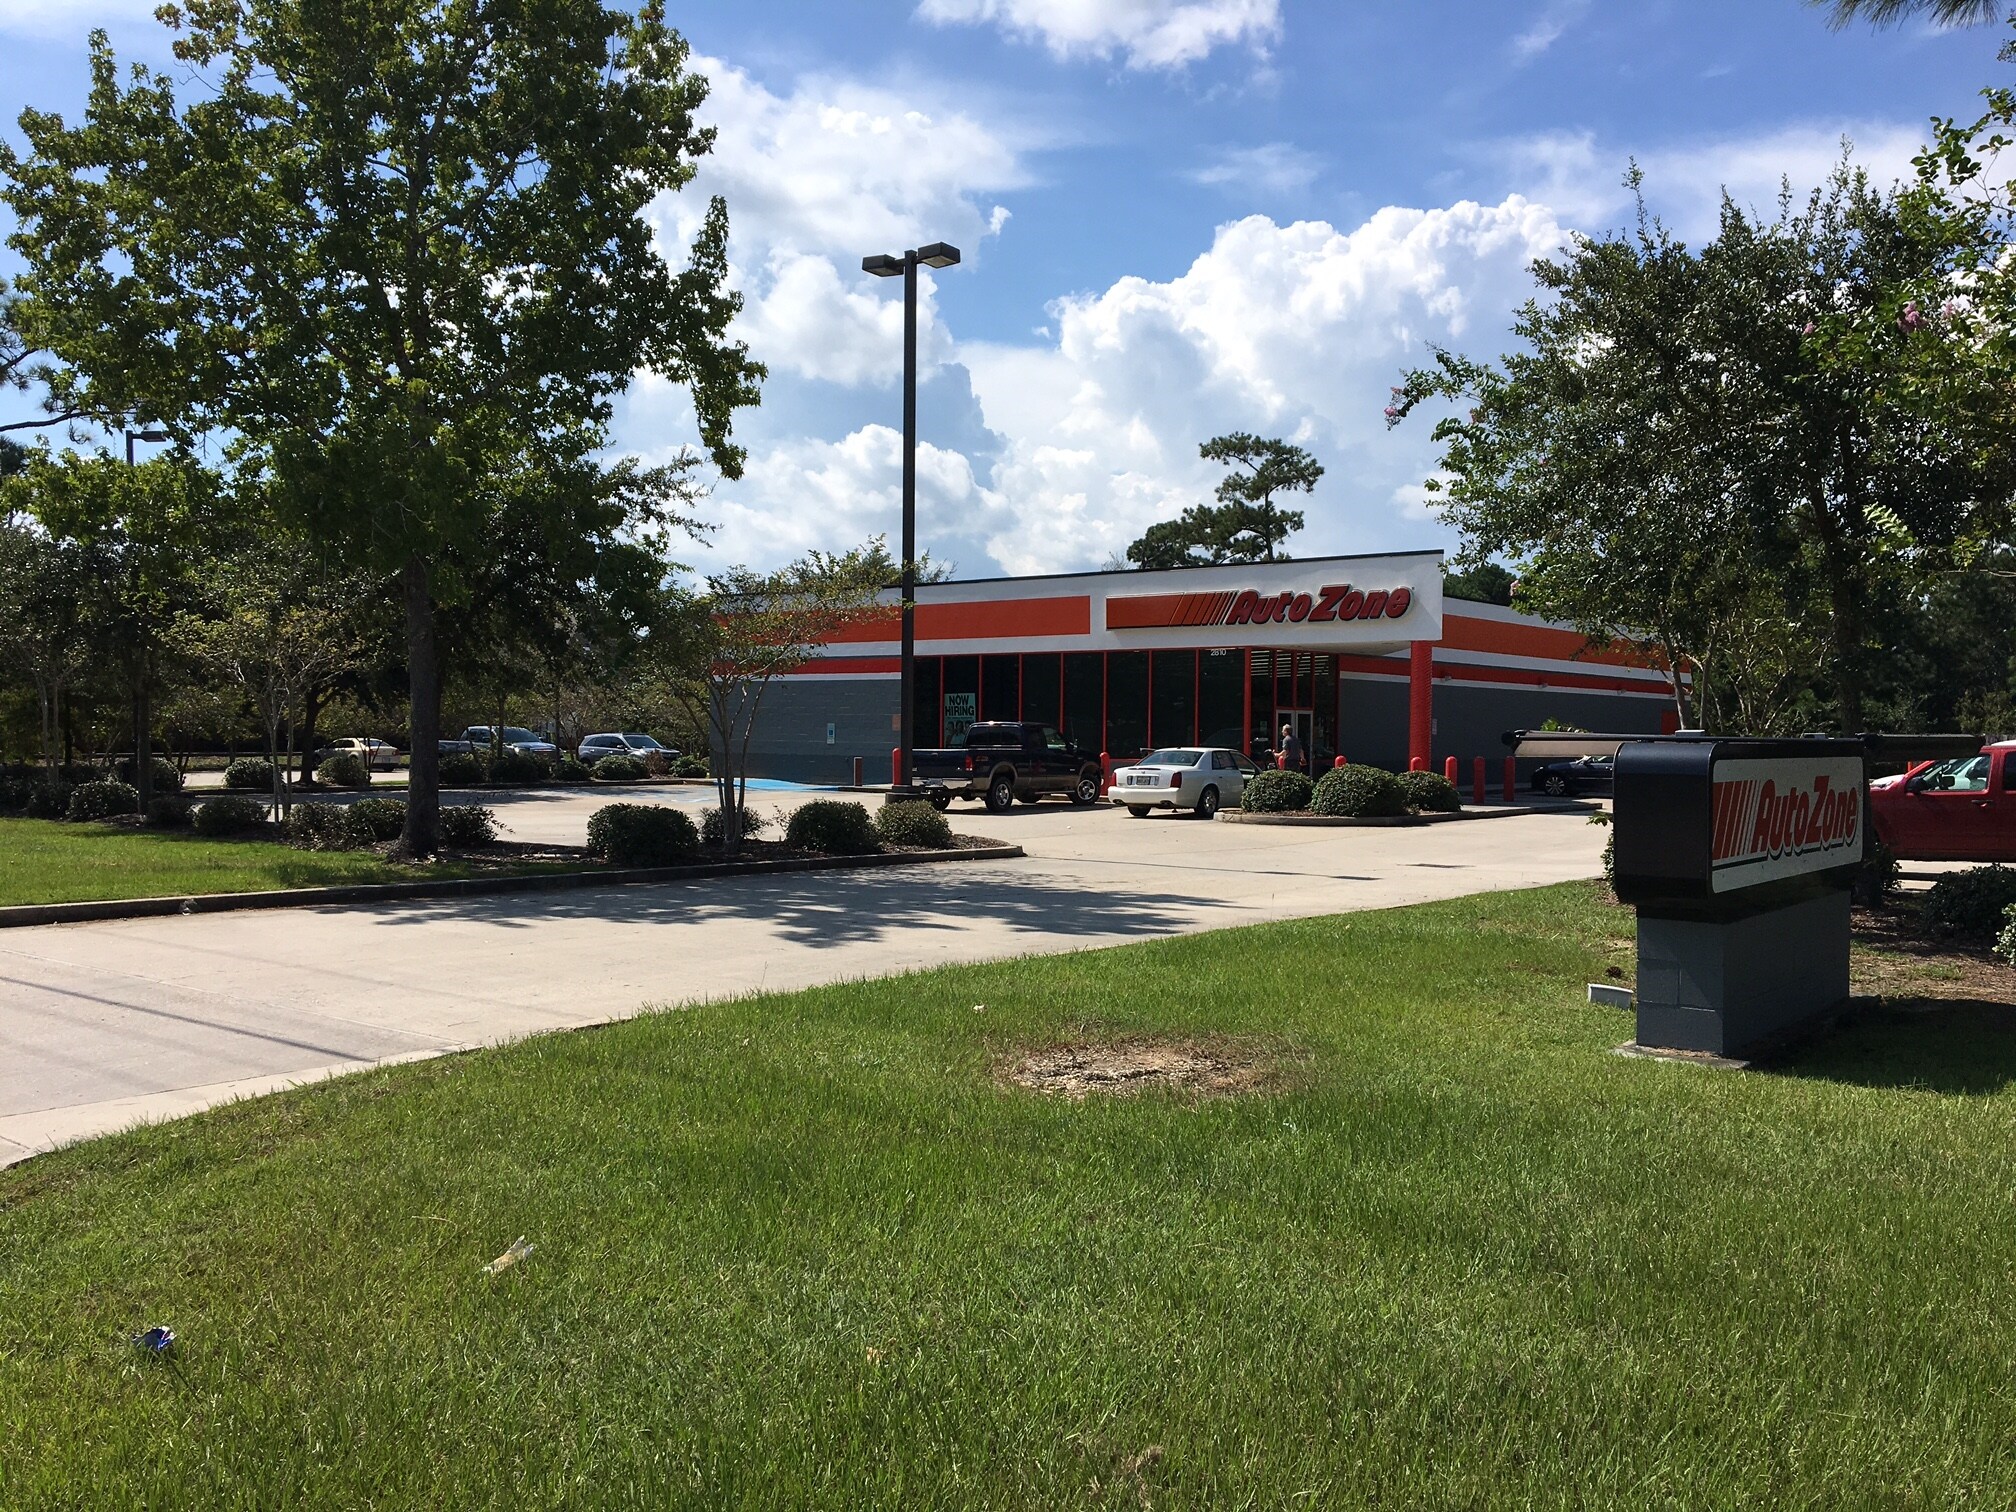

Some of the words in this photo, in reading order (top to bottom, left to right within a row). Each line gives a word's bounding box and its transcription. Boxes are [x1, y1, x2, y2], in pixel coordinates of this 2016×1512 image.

[1225, 584, 1412, 625] AutoZone
[945, 705, 975, 716] HIRING
[948, 694, 969, 705] NOW
[1750, 775, 1858, 855] AutoZone
